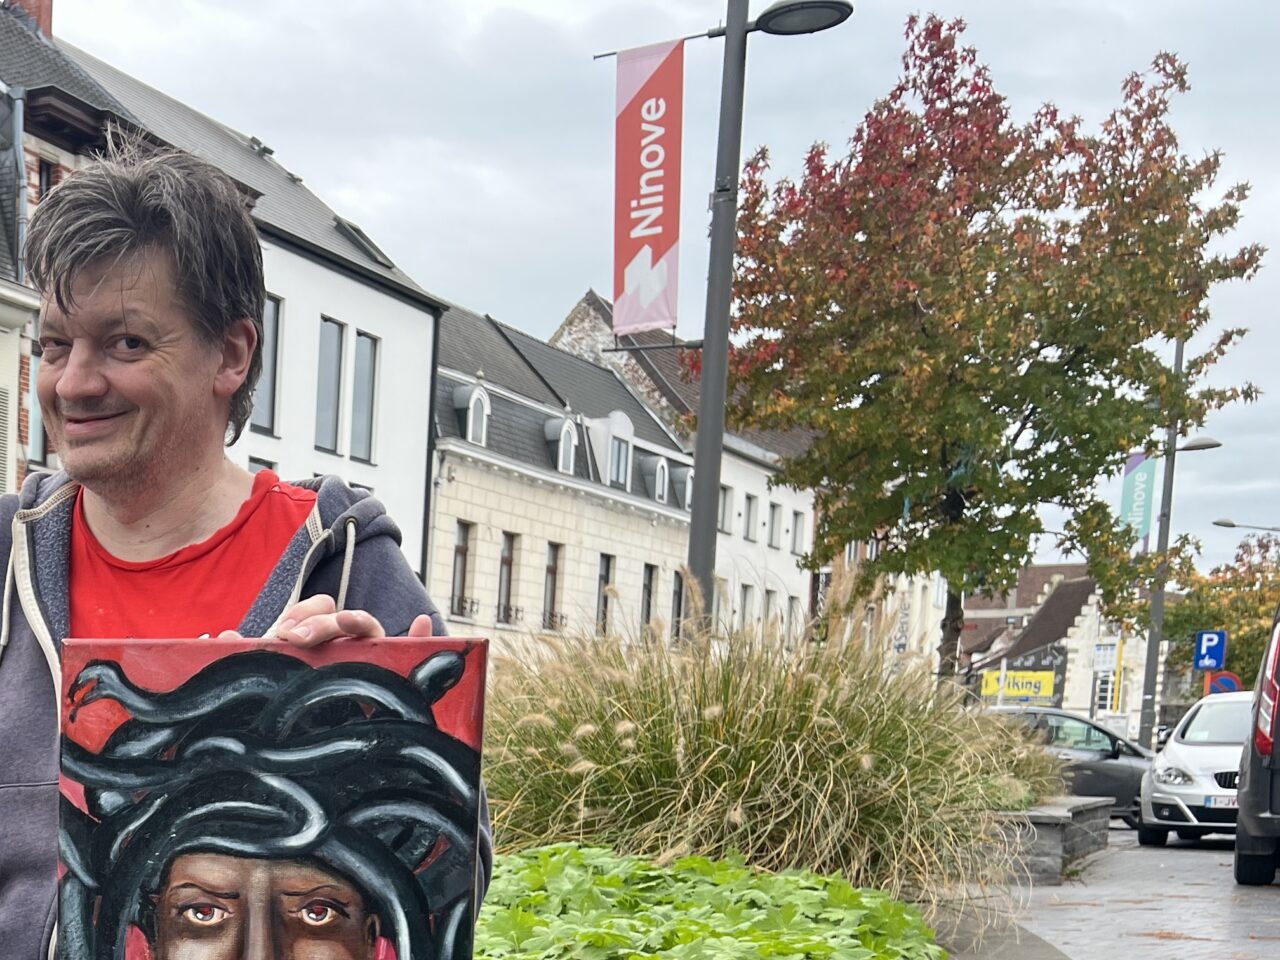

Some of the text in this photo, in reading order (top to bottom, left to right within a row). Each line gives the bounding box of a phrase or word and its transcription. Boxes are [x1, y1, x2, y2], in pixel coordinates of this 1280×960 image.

[630, 97, 666, 239] Ninove
[1127, 471, 1148, 528] Ninove
[1201, 633, 1219, 655] P
